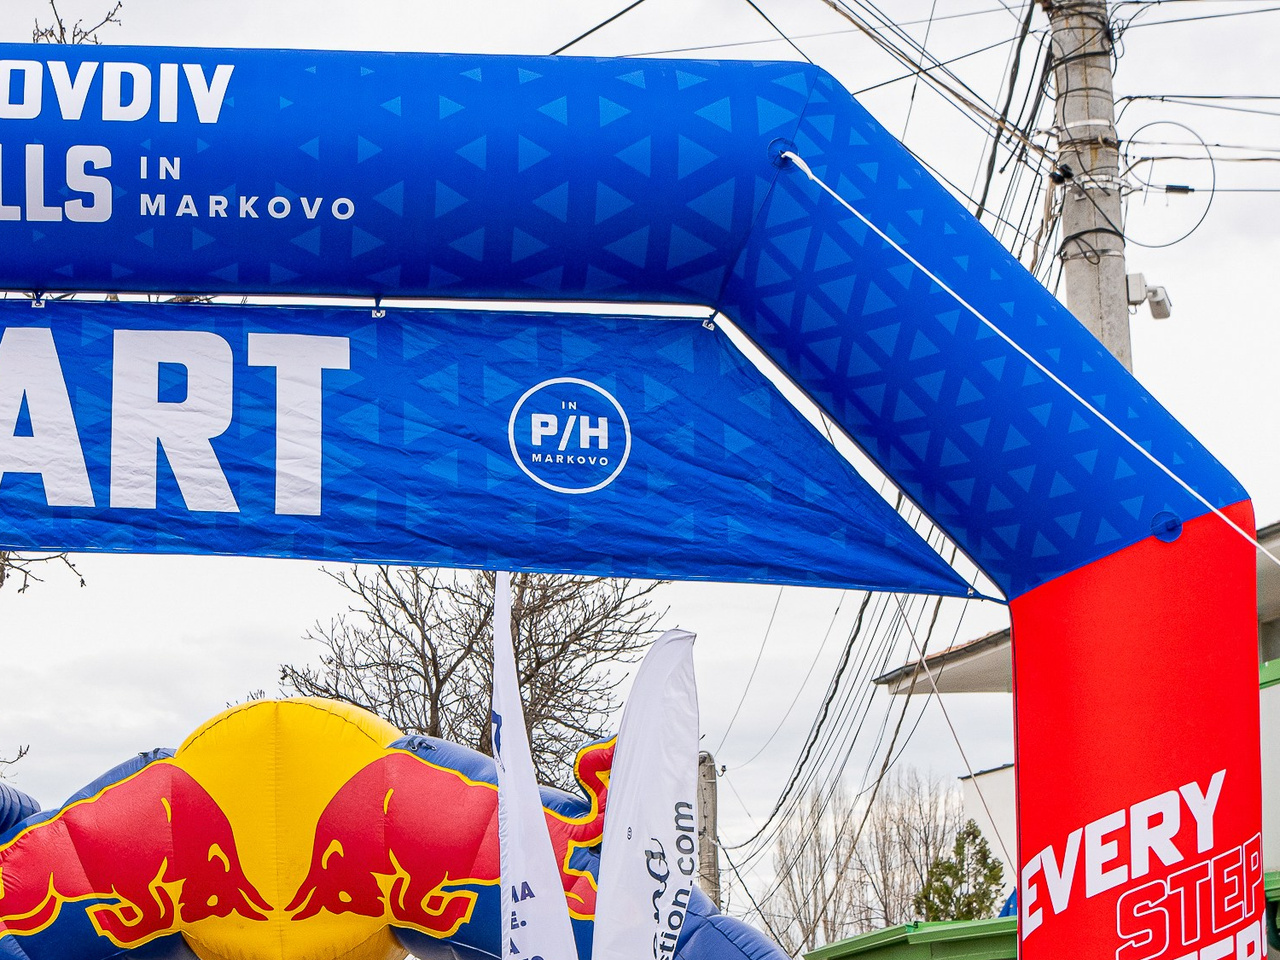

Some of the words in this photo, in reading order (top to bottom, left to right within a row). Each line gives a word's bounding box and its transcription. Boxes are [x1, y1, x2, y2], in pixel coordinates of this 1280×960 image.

[140, 156, 181, 180] IN
[140, 193, 356, 221] MARKOVO
[561, 401, 577, 410] IN
[531, 413, 609, 451] P/H
[531, 453, 609, 466] MARKOVO
[1022, 769, 1227, 942] EVERY
